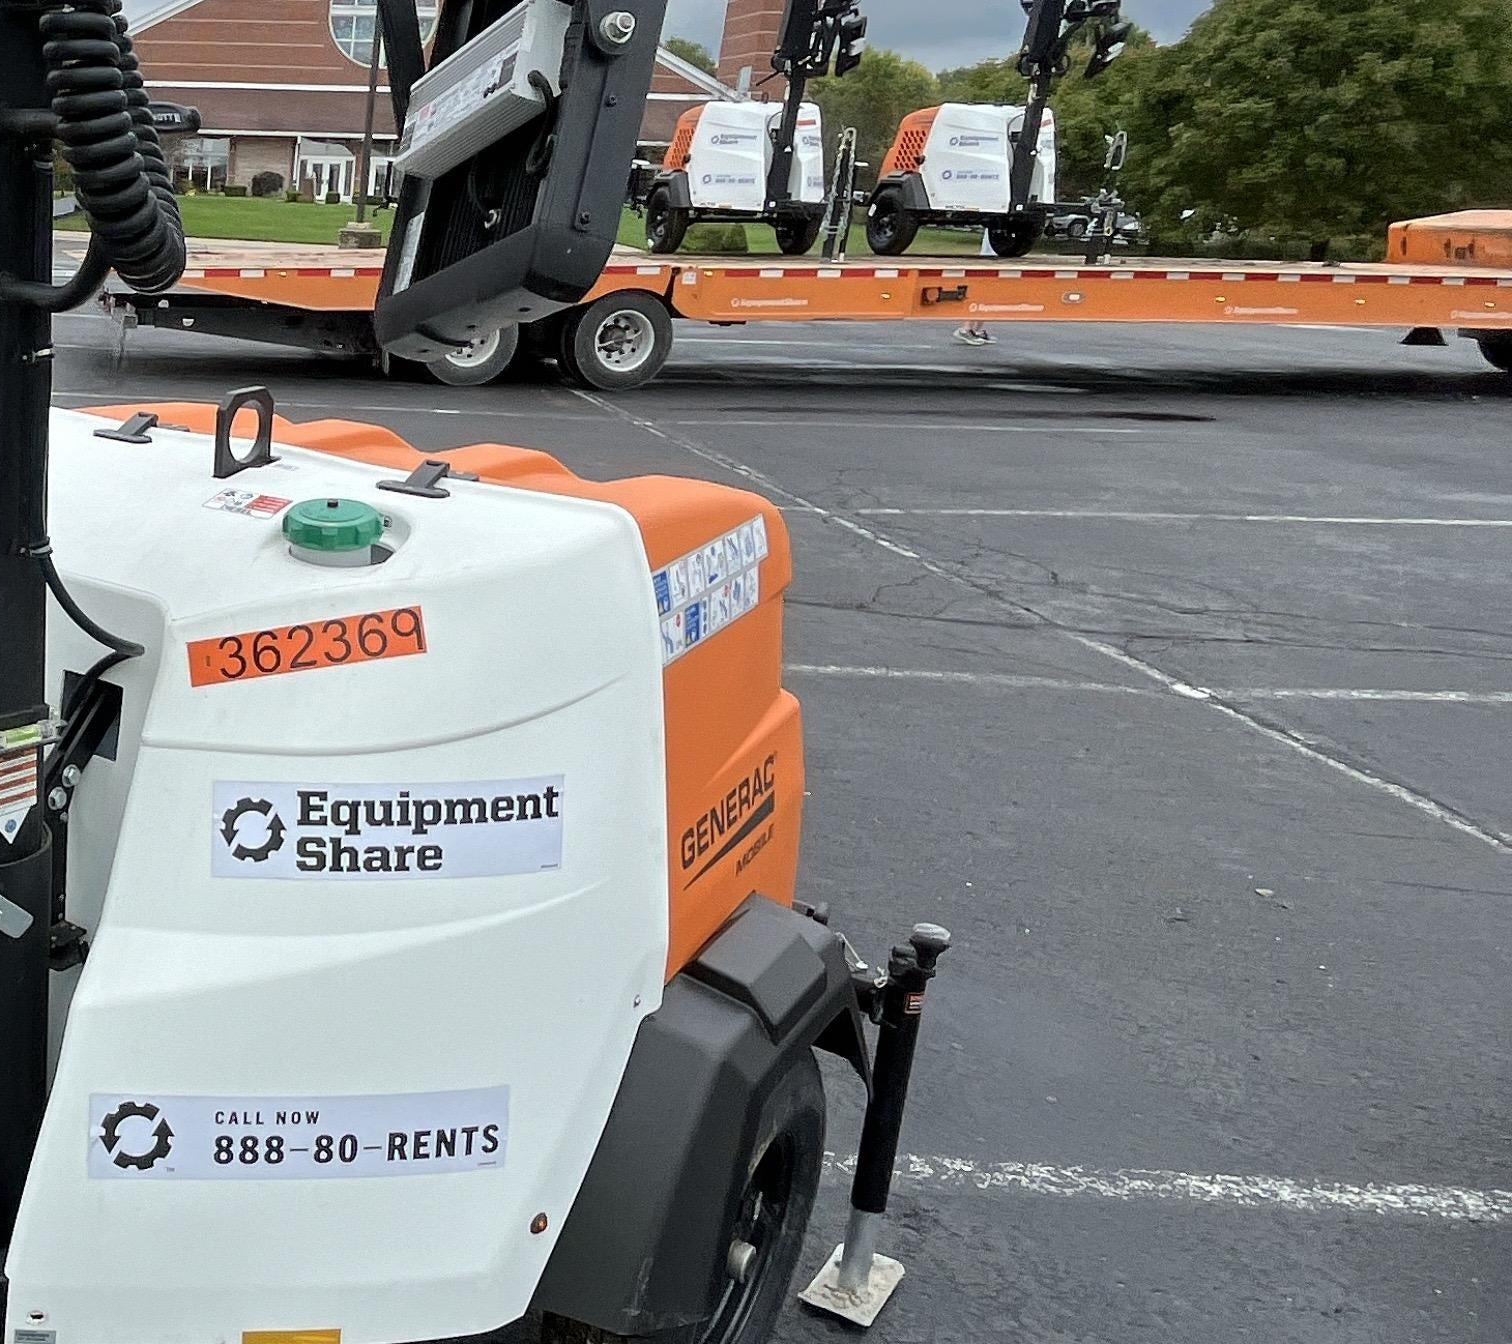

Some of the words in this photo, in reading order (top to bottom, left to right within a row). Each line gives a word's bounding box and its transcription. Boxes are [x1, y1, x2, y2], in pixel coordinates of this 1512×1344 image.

[218, 607, 424, 679] 362369
[296, 785, 560, 836] Equipment
[681, 753, 776, 870] GENERAC
[295, 836, 444, 873] Share
[214, 1110, 265, 1126] CALL
[275, 1110, 321, 1125] NOW
[213, 1124, 500, 1166] 888-80-RENTS
